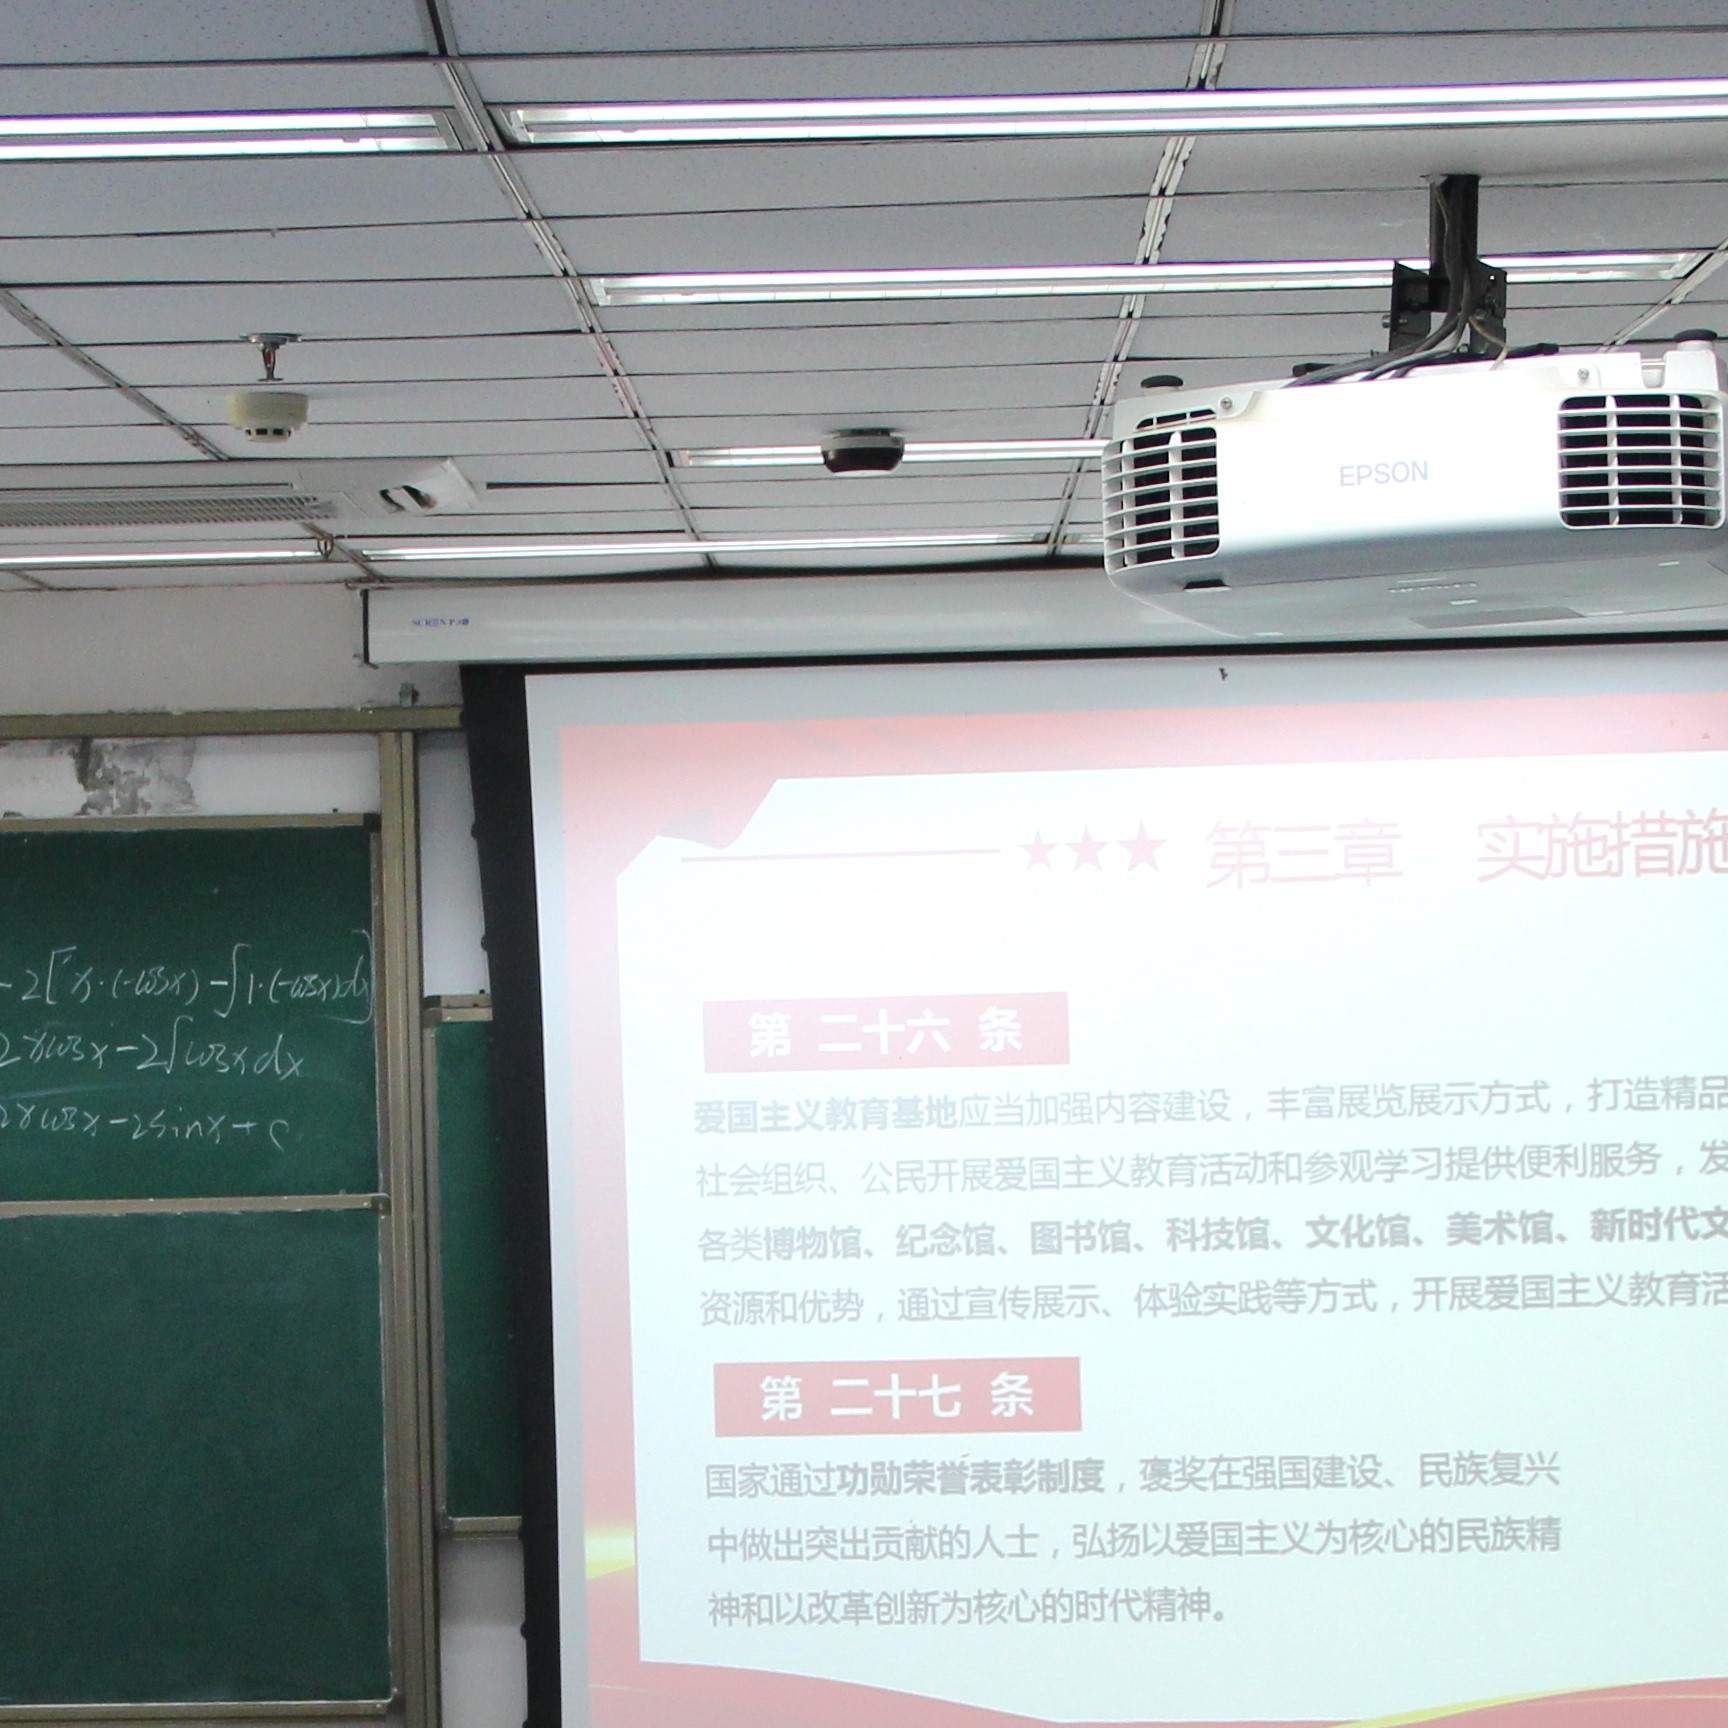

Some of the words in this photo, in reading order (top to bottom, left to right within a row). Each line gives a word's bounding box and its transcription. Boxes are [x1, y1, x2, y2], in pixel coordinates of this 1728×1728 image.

[1338, 460, 1429, 487] EPSON
[1205, 816, 1404, 889] 第三章
[747, 1010, 792, 1057] 第
[818, 1008, 952, 1055] 二十六
[978, 1005, 1023, 1051] 条
[760, 1375, 803, 1421] 第
[830, 1373, 962, 1419] 二十七
[990, 1371, 1035, 1418] 条
